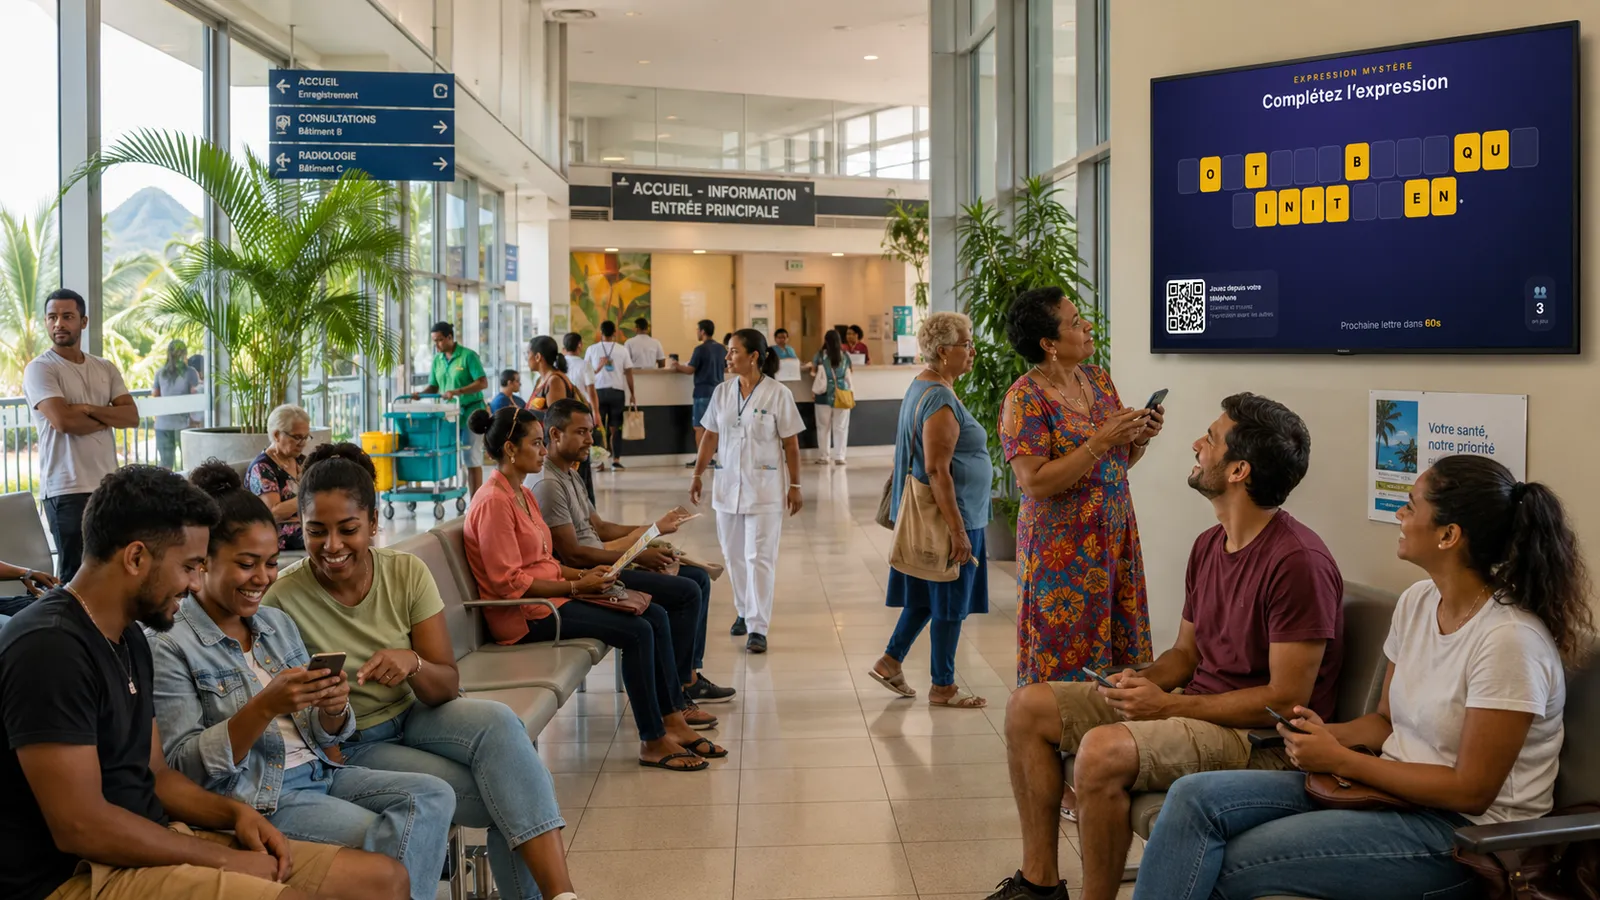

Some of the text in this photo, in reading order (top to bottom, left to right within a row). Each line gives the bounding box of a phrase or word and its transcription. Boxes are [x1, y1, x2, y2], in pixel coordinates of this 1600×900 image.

[1293, 61, 1413, 84] EXPRESSION MYSTÈRE
[298, 77, 339, 87] ACCUEIL
[298, 90, 359, 100] Enregistrement
[1262, 75, 1448, 109] Complétez l'expression
[298, 114, 377, 124] CONSULTATIONS
[298, 127, 343, 136] Bâtiment B
[299, 151, 357, 161] RADIOLOGIE
[298, 164, 344, 173] Bâtiment C
[632, 182, 693, 197] ACCUEIL
[708, 185, 796, 201] INFORMATION
[651, 199, 779, 219] ENTRÉE PRINCIPALE
[1536, 302, 1544, 315] 3
[1341, 318, 1442, 330] Prochaine lettre dans 60s
[1428, 422, 1488, 439] Votre santé,
[1428, 439, 1495, 455] notre priorité
